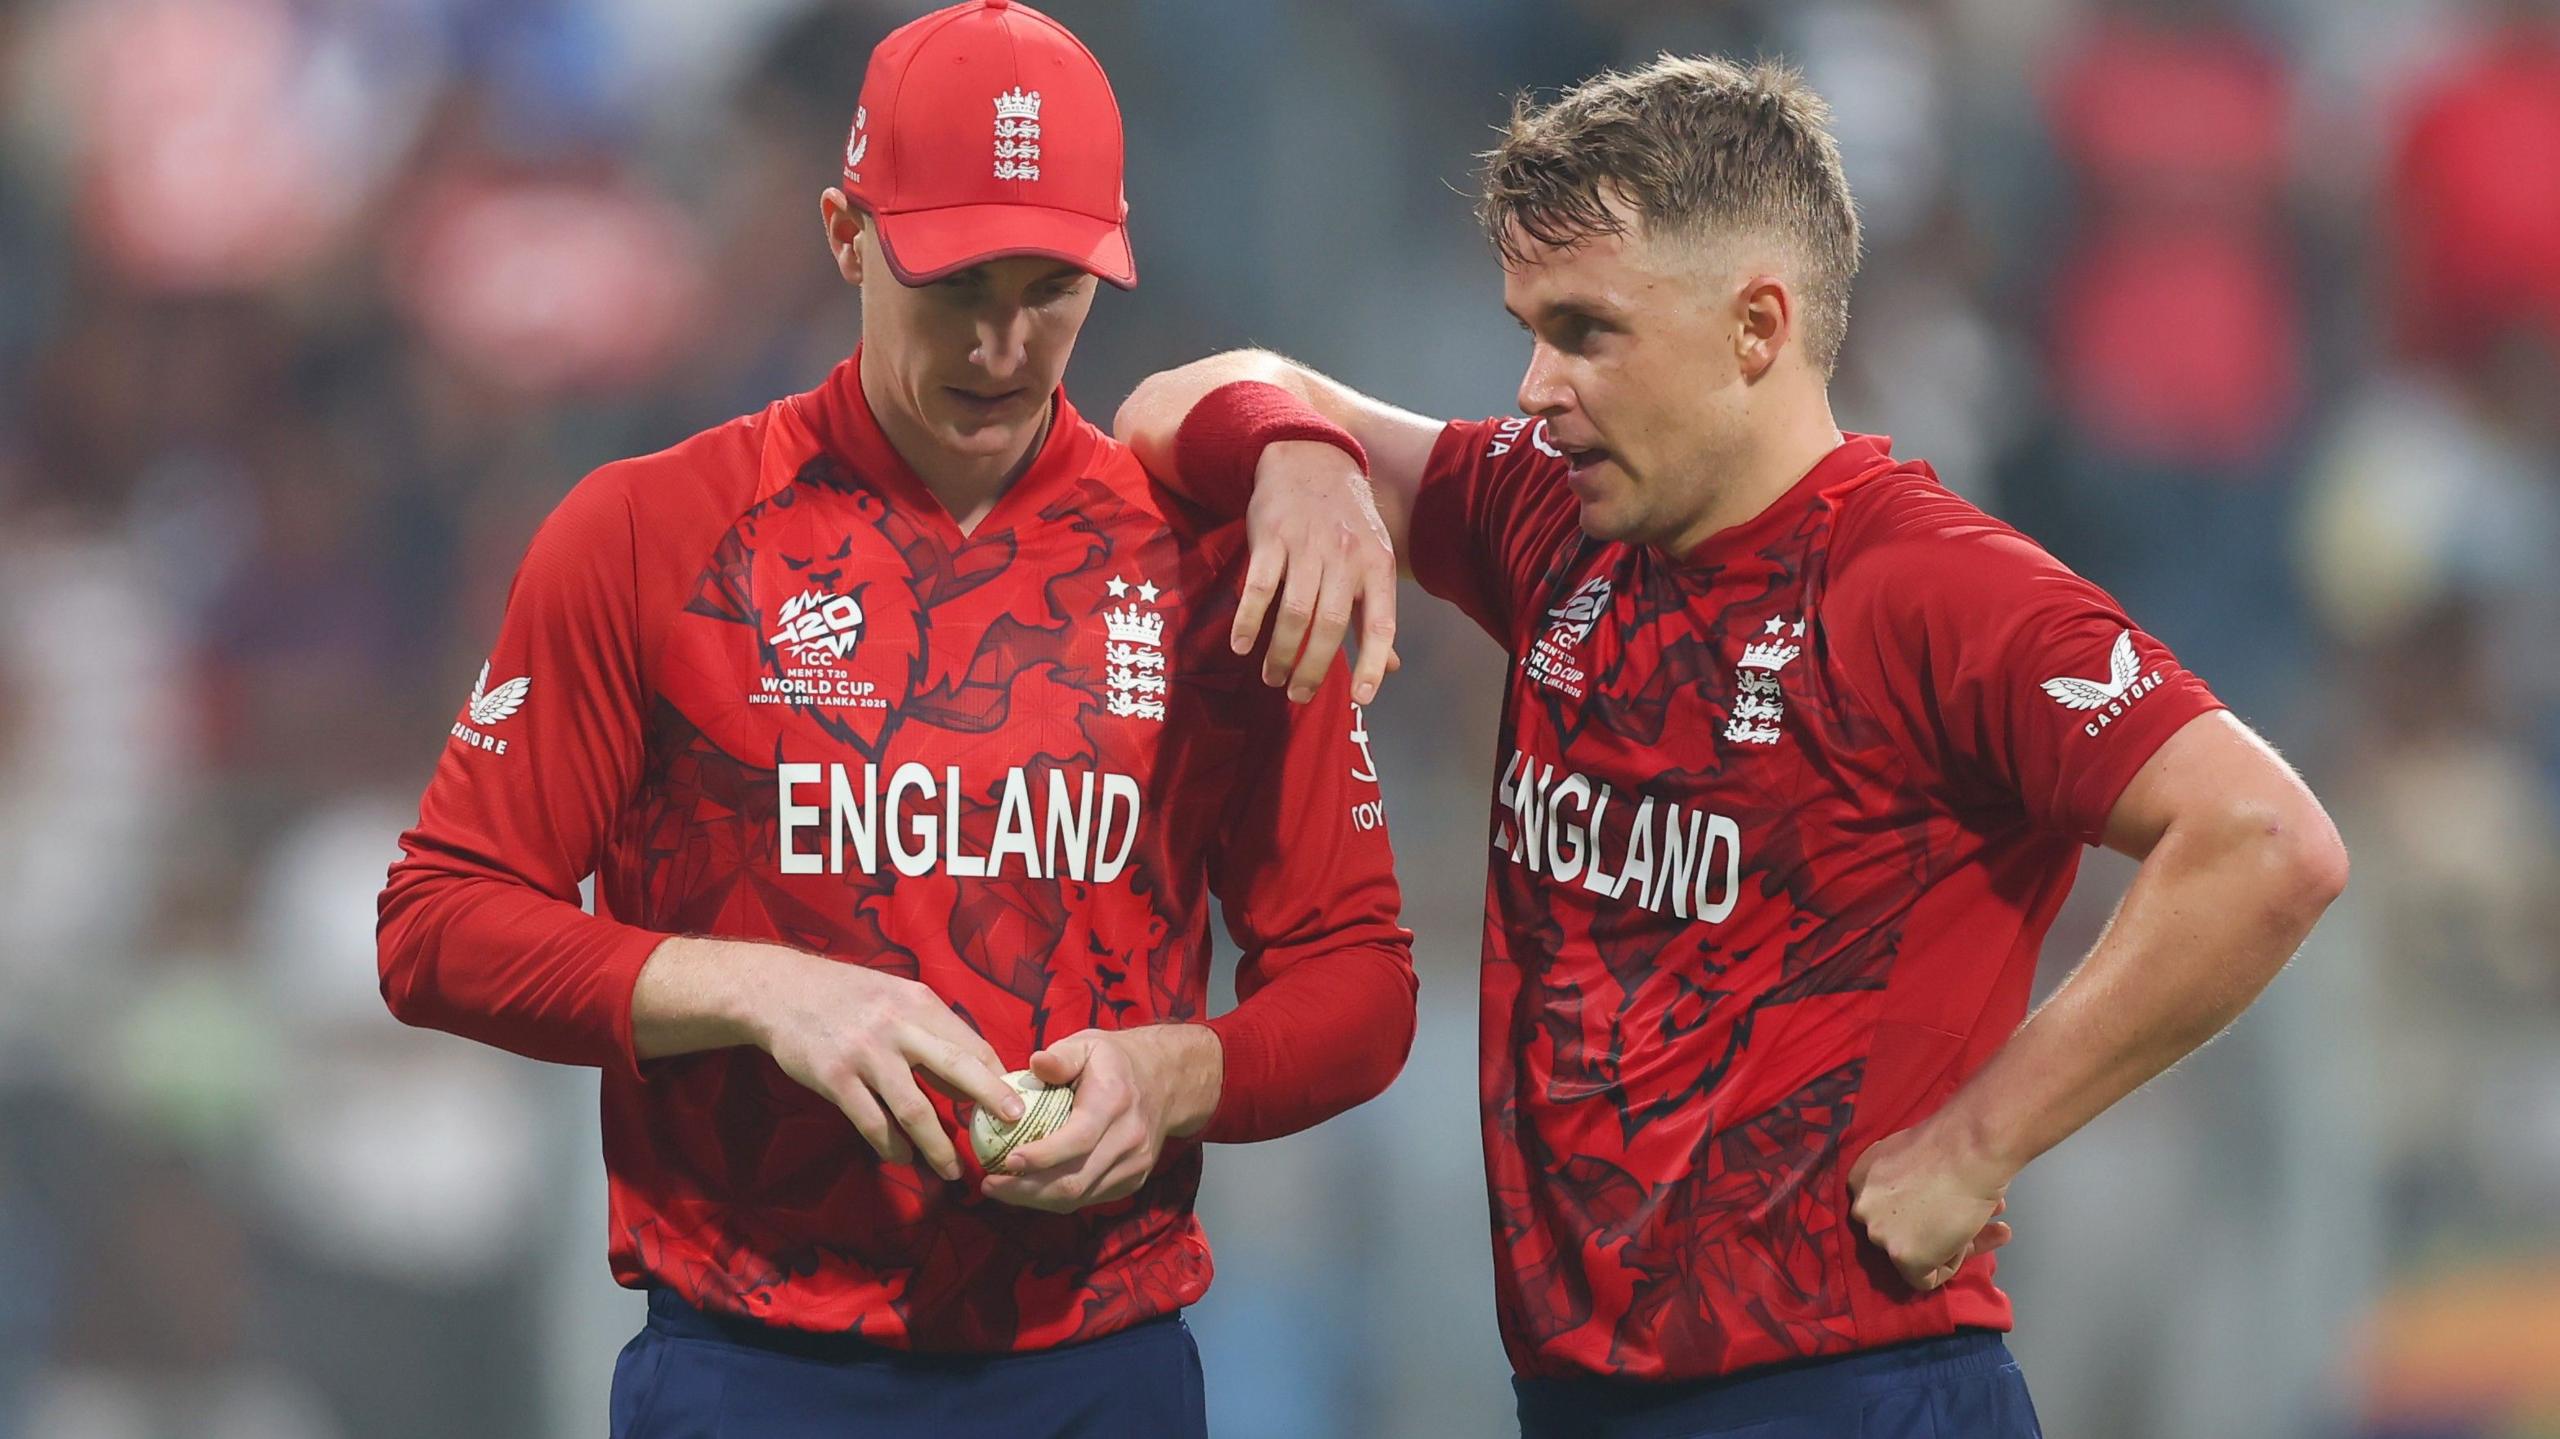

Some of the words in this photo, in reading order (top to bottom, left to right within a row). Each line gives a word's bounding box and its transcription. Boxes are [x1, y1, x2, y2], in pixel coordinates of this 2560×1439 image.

[1486, 418, 1531, 458] OTA
[769, 595, 863, 646] T20
[801, 652, 833, 666] ICC
[1536, 640, 1565, 660] MEN'S
[787, 668, 824, 678] MEN'S
[828, 669, 848, 679] T20
[1527, 667, 1543, 680] SRI
[1560, 667, 1584, 683] CUP
[761, 678, 832, 694] WORLD
[836, 682, 875, 696] CUP
[749, 695, 781, 704] INDIA
[784, 696, 792, 705] &
[795, 696, 814, 705] SRI
[817, 696, 857, 707] LANKA
[860, 699, 887, 708] 2026
[2085, 671, 2164, 737] CASTORE
[778, 762, 1141, 883] ENGLAND
